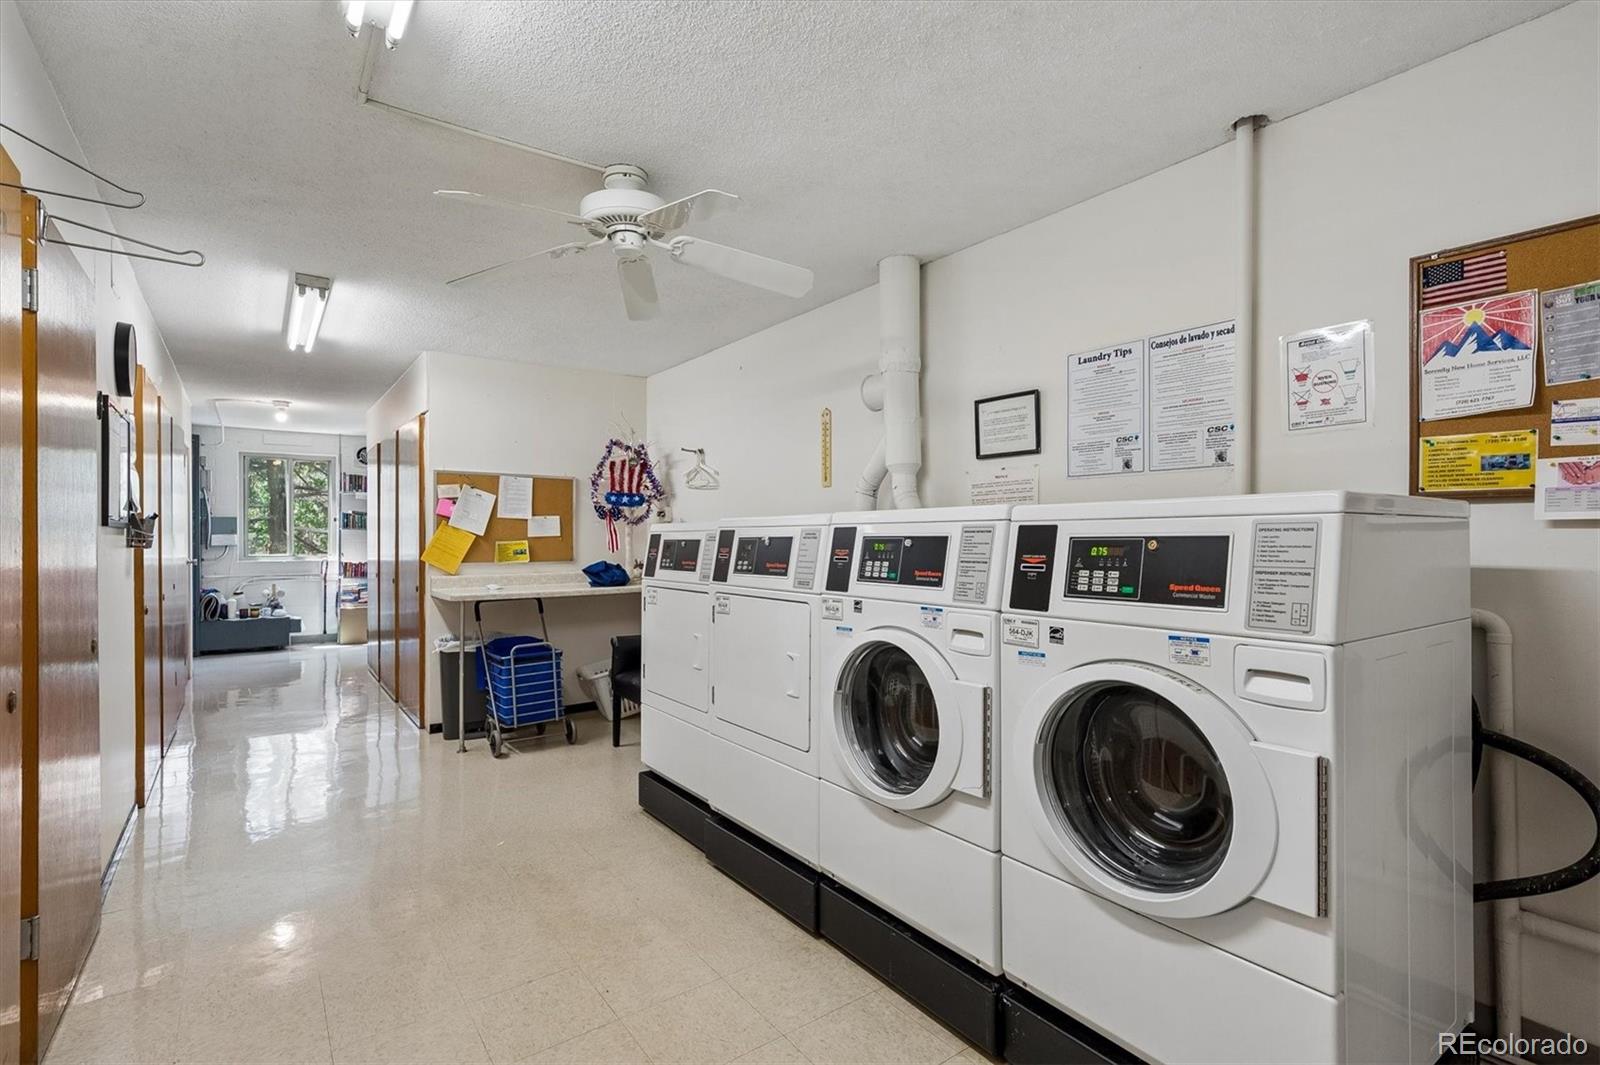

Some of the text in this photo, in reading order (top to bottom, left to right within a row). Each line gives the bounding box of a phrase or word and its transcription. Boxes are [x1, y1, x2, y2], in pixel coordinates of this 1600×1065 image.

[1150, 338, 1179, 350] Consejos
[1179, 335, 1187, 344] de
[1188, 331, 1209, 343] lavado
[1078, 347, 1132, 366] Laundry Tips
[1517, 353, 1531, 361] LLC
[1207, 424, 1229, 433] CSC
[1116, 435, 1134, 443] CSC
[1169, 583, 1221, 593] Speed Queen
